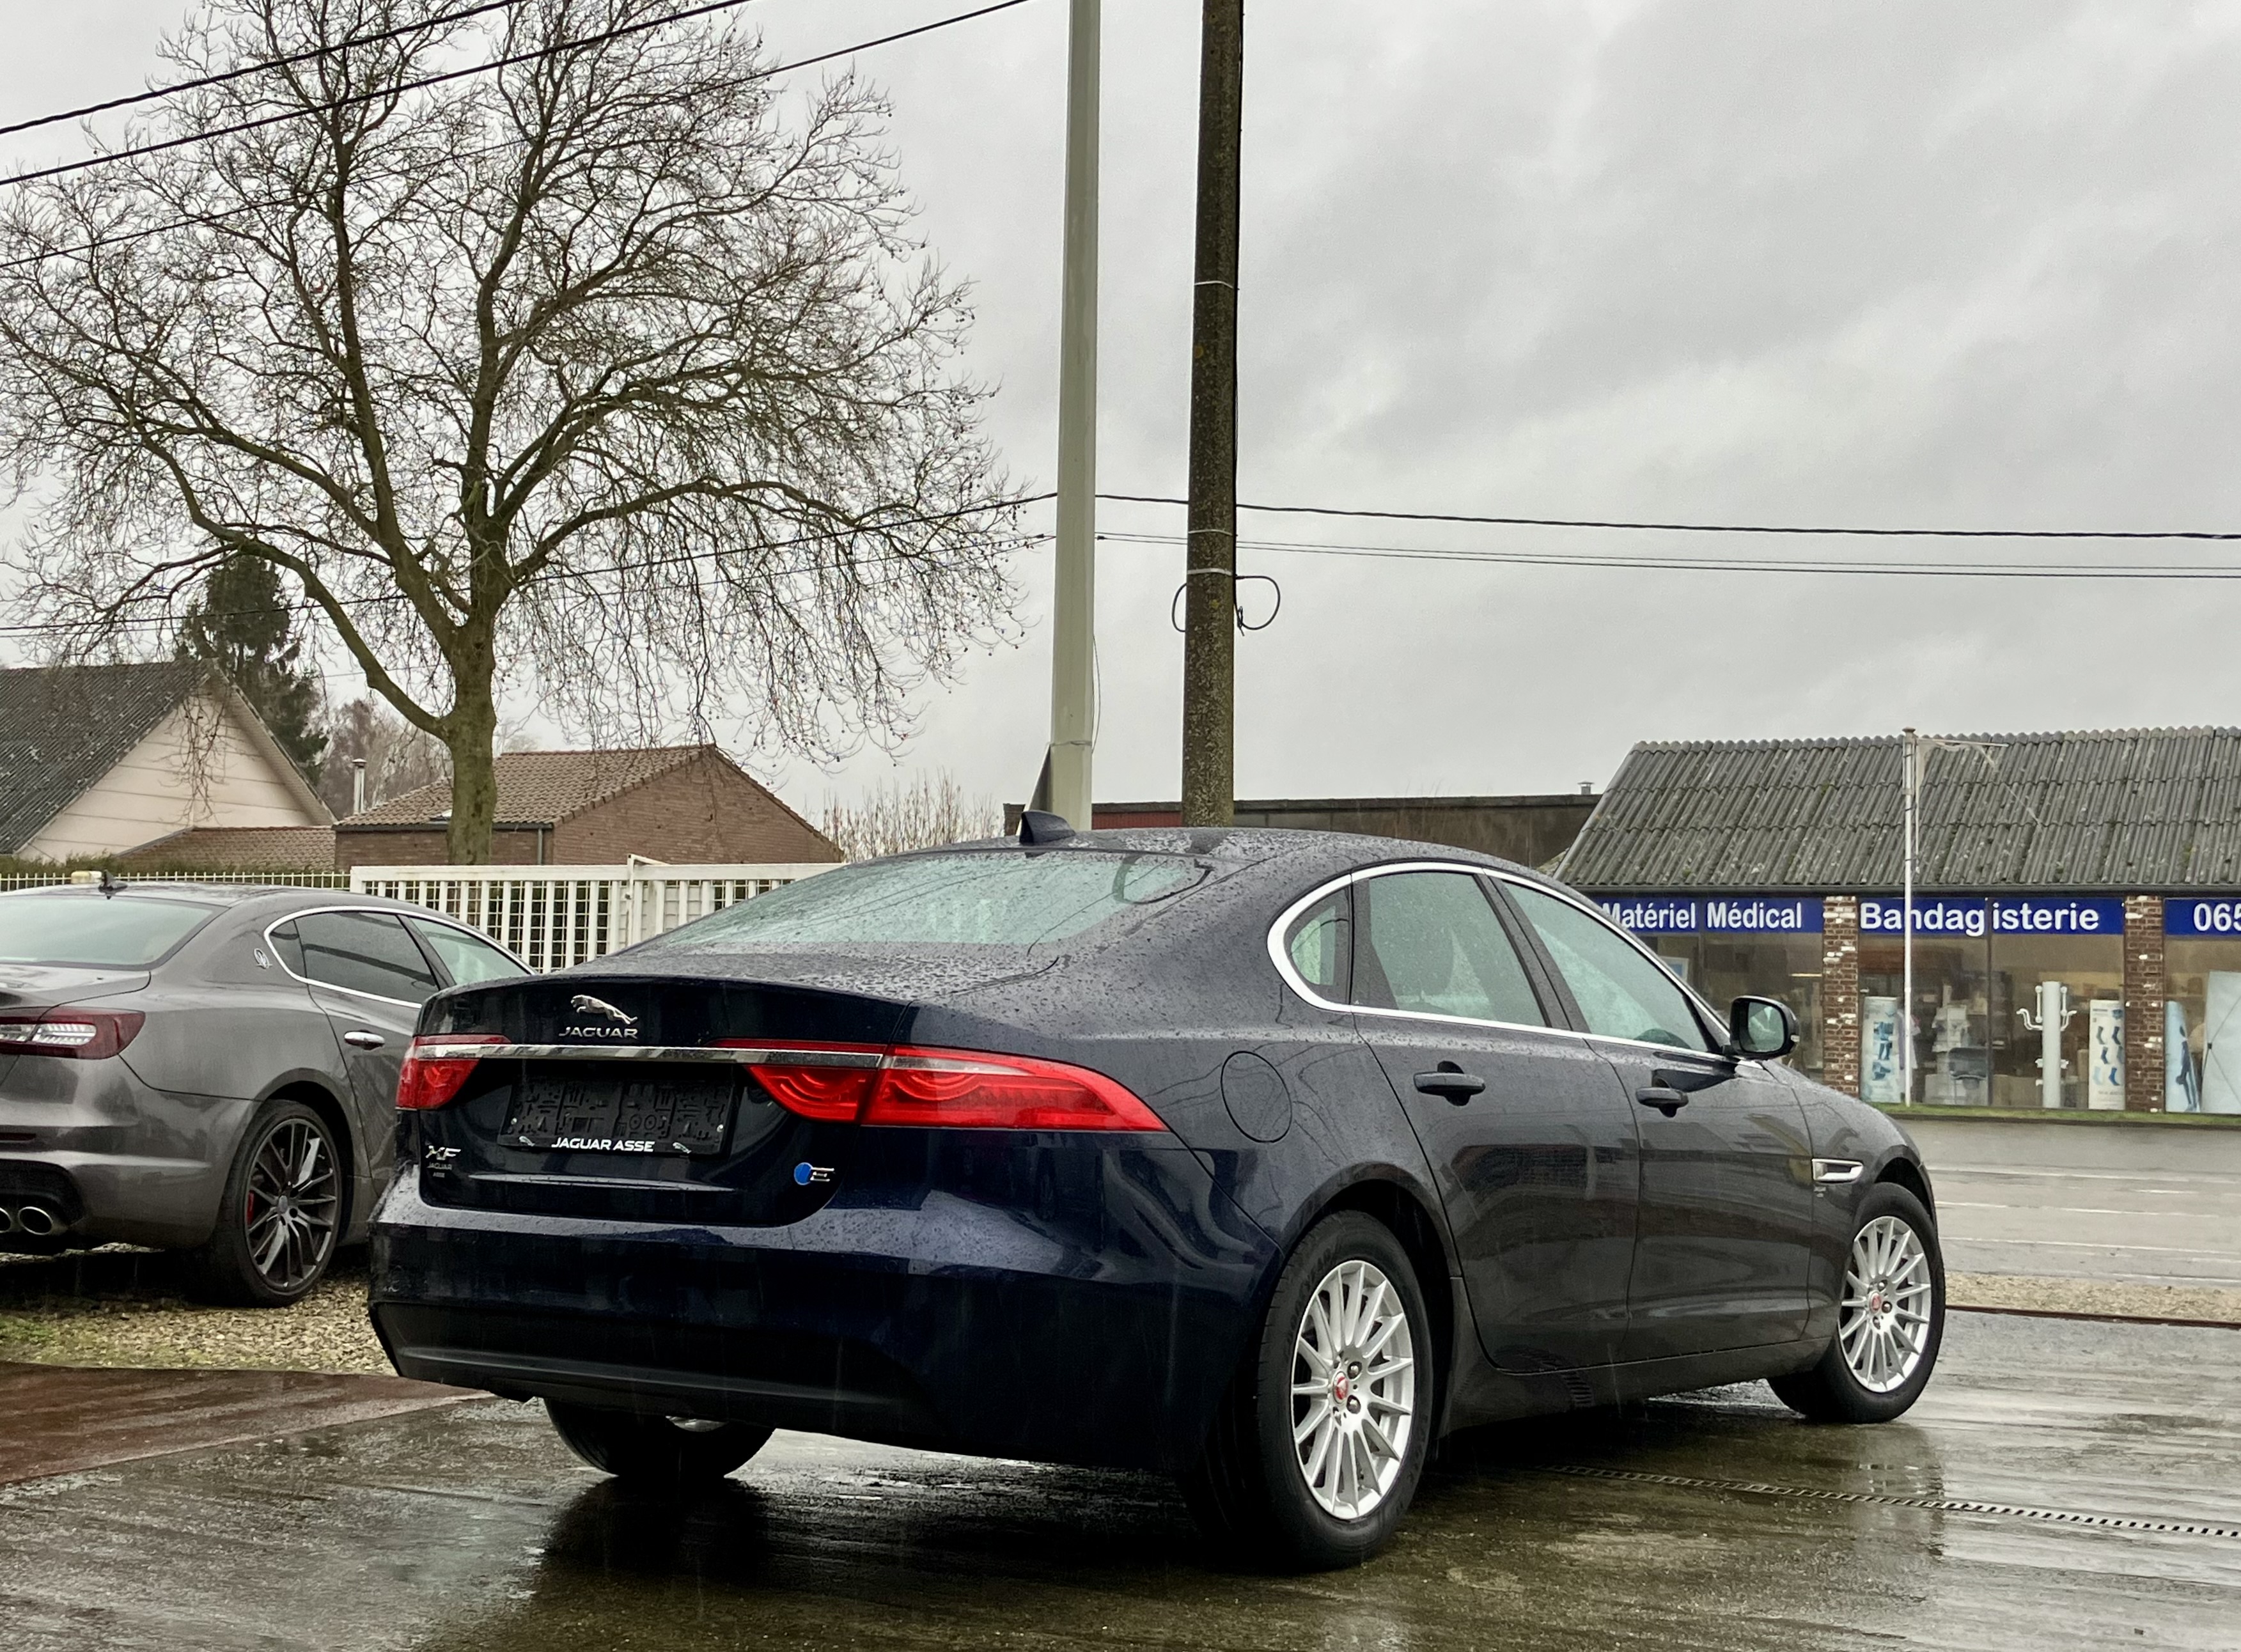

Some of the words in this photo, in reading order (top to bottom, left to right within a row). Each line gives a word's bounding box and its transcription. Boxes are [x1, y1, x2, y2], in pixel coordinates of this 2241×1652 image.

[1602, 901, 1696, 928] Matériel
[1707, 901, 1802, 928] Médical
[558, 1026, 638, 1039] JAGUAR
[551, 1137, 612, 1151] JAGUAR
[613, 1139, 655, 1152] ASSE
[425, 1145, 462, 1160] XF
